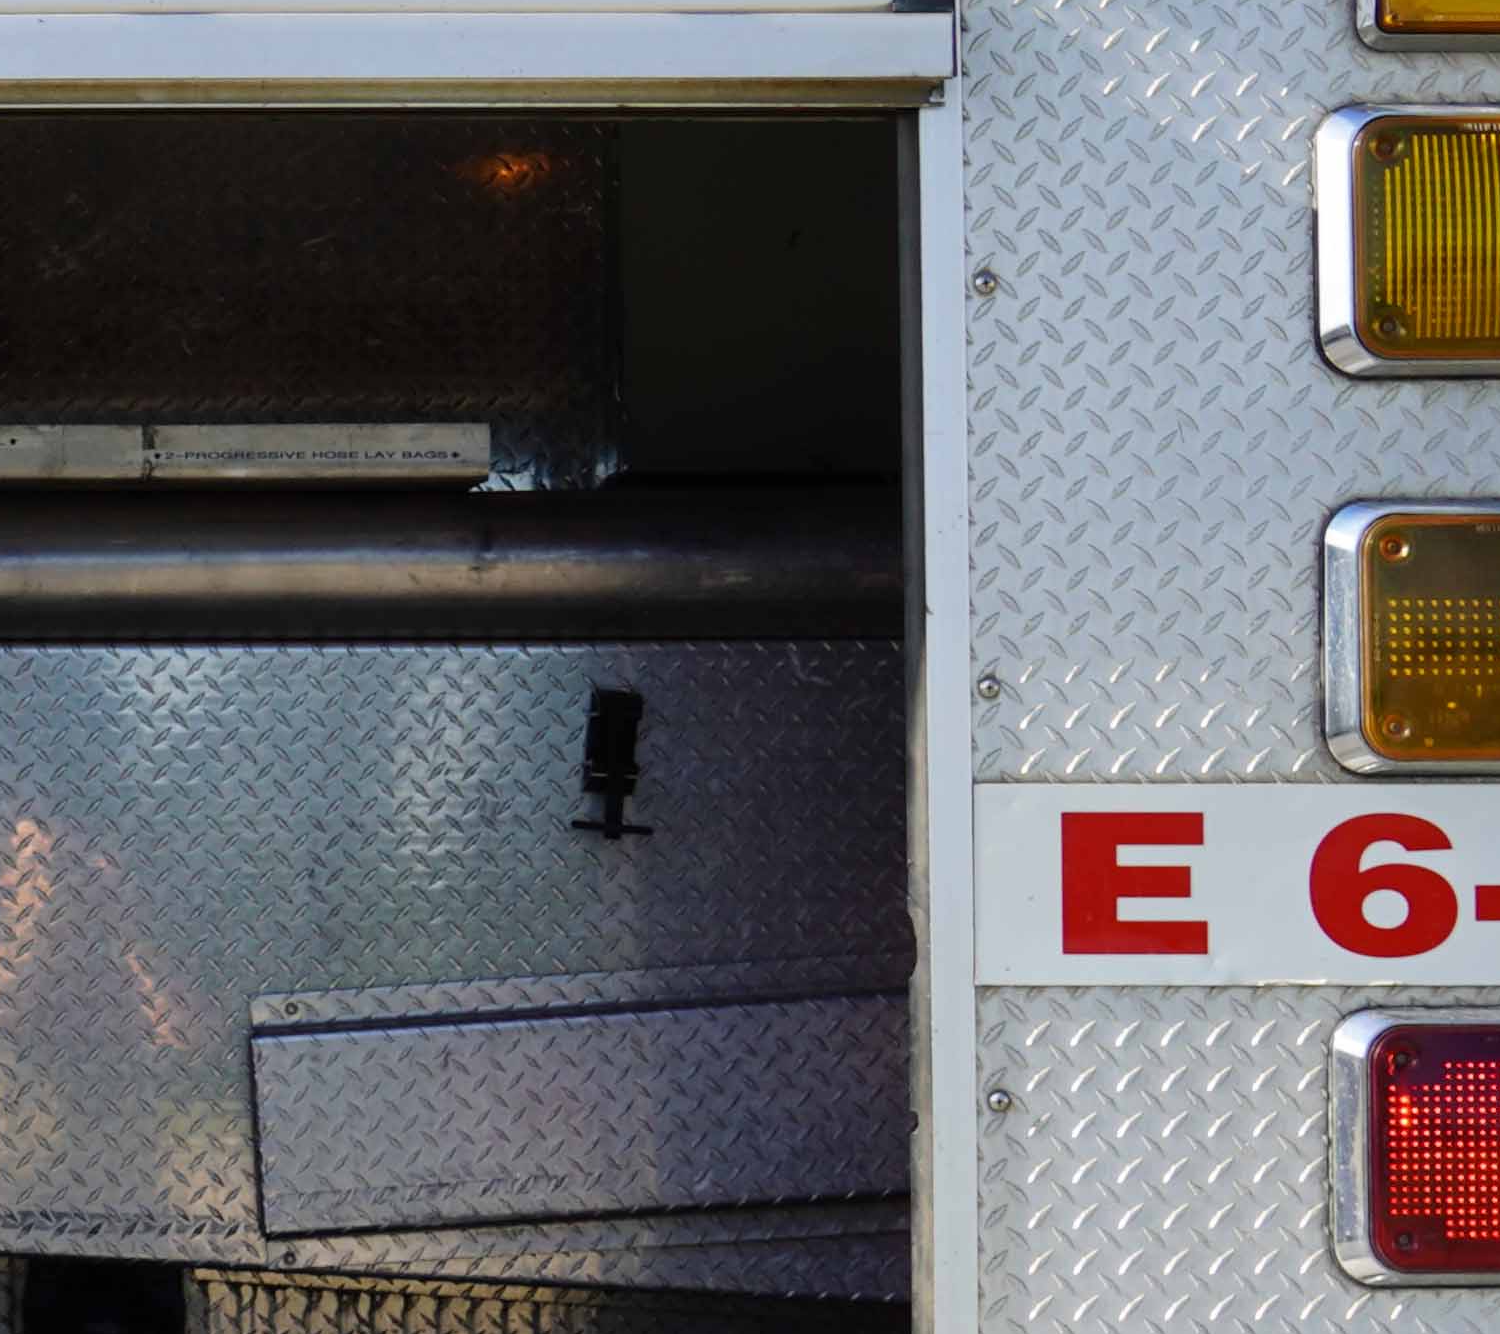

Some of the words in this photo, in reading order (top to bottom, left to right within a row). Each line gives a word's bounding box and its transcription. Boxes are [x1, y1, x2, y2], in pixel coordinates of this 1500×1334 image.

[311, 450, 360, 460] HOSE
[364, 450, 397, 460] LAY
[401, 450, 449, 460] BAGS
[1061, 811, 1208, 955] E
